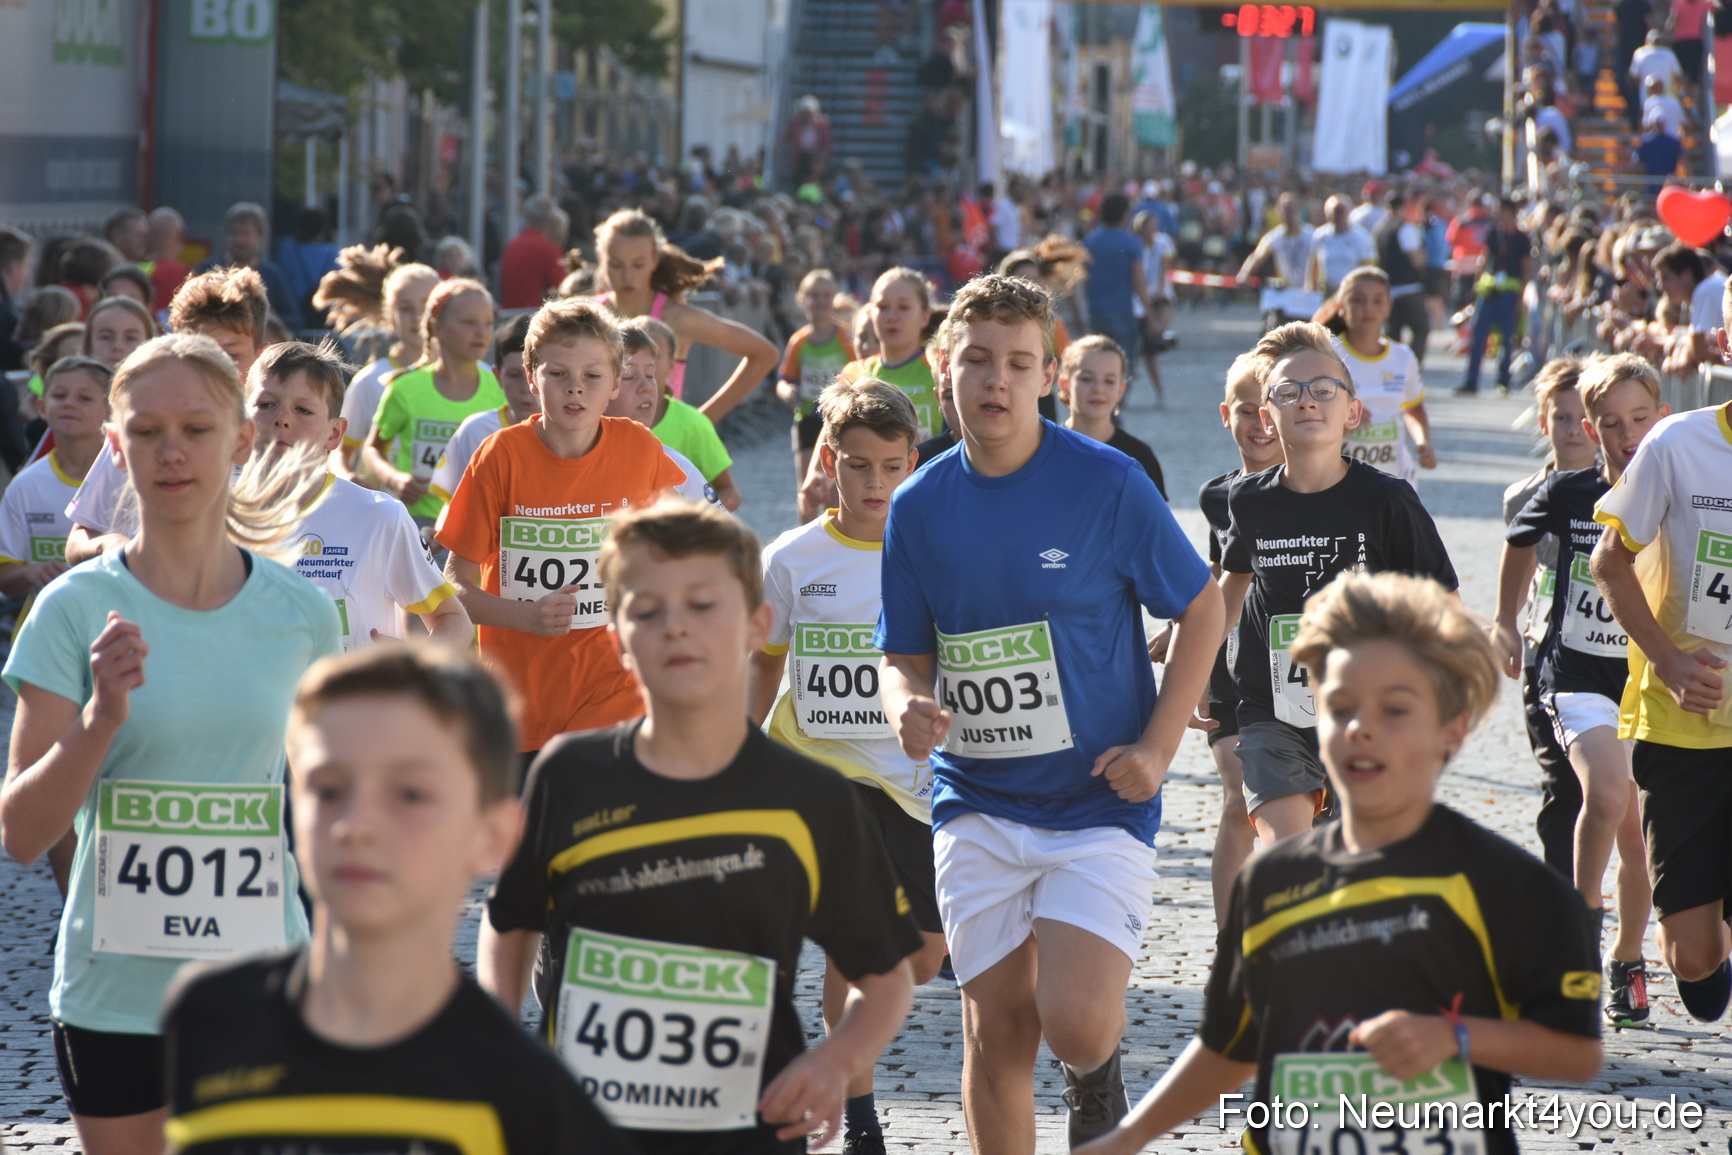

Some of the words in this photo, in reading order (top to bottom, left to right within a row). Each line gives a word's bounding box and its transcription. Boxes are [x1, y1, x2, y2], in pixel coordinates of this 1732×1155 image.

[422, 446, 446, 468] 4
[515, 502, 596, 517] Neumarkter
[324, 547, 348, 555] JAHRE
[1256, 535, 1330, 550] Neumarkter
[297, 558, 355, 567] Neumarkter
[1258, 552, 1315, 568] Stadtlauf
[1586, 631, 1629, 647] JAKO
[943, 672, 1043, 715] 4003
[960, 725, 1033, 743] JUSTIN
[112, 788, 271, 831] BOCK
[117, 844, 262, 898] 4012
[164, 916, 220, 938] EVA
[578, 939, 754, 1000] BOCK
[576, 1002, 741, 1068] 4036
[581, 1075, 721, 1108] DOMINIK
